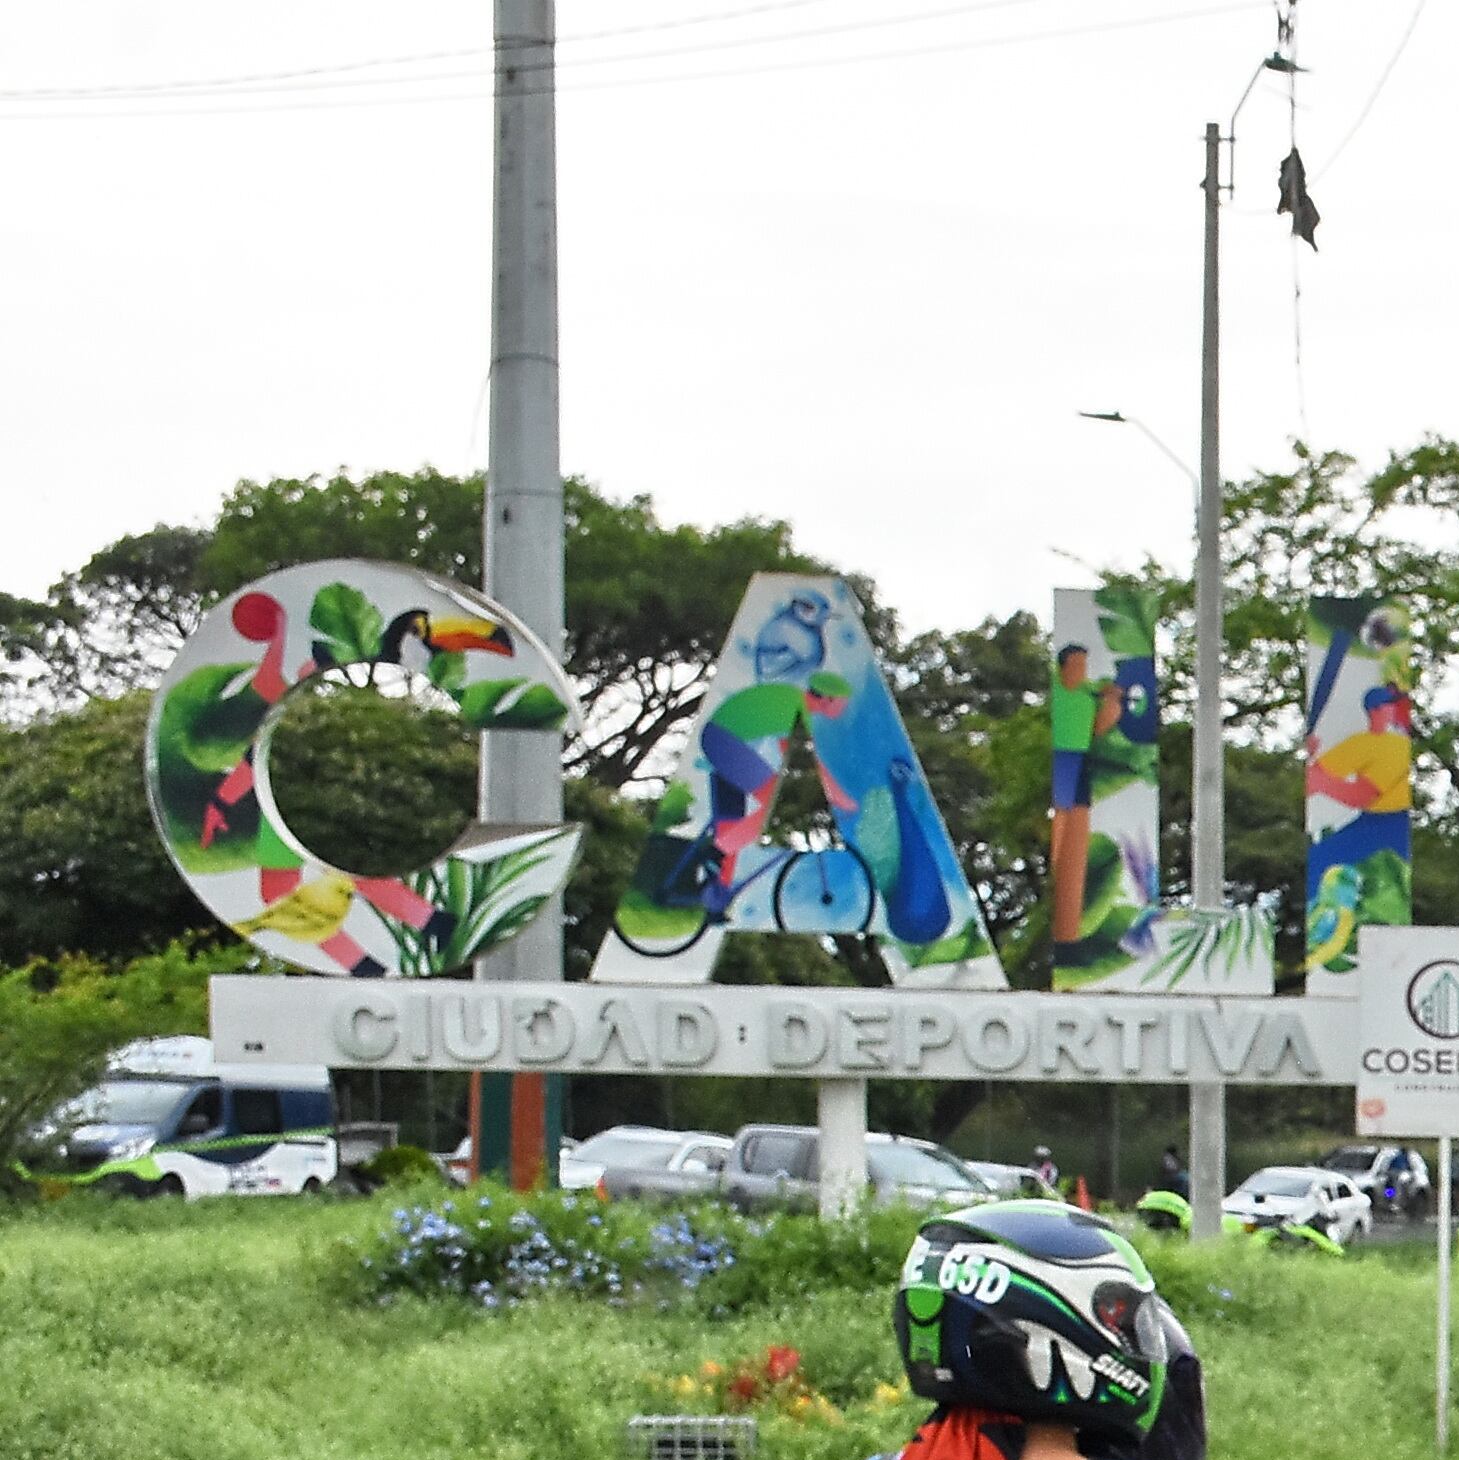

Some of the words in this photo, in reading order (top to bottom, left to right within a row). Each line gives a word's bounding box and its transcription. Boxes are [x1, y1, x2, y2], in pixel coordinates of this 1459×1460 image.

[146, 557, 1411, 995] CALI
[334, 996, 719, 1068] CIUDAD
[766, 1001, 1321, 1077] DEPORTIVA
